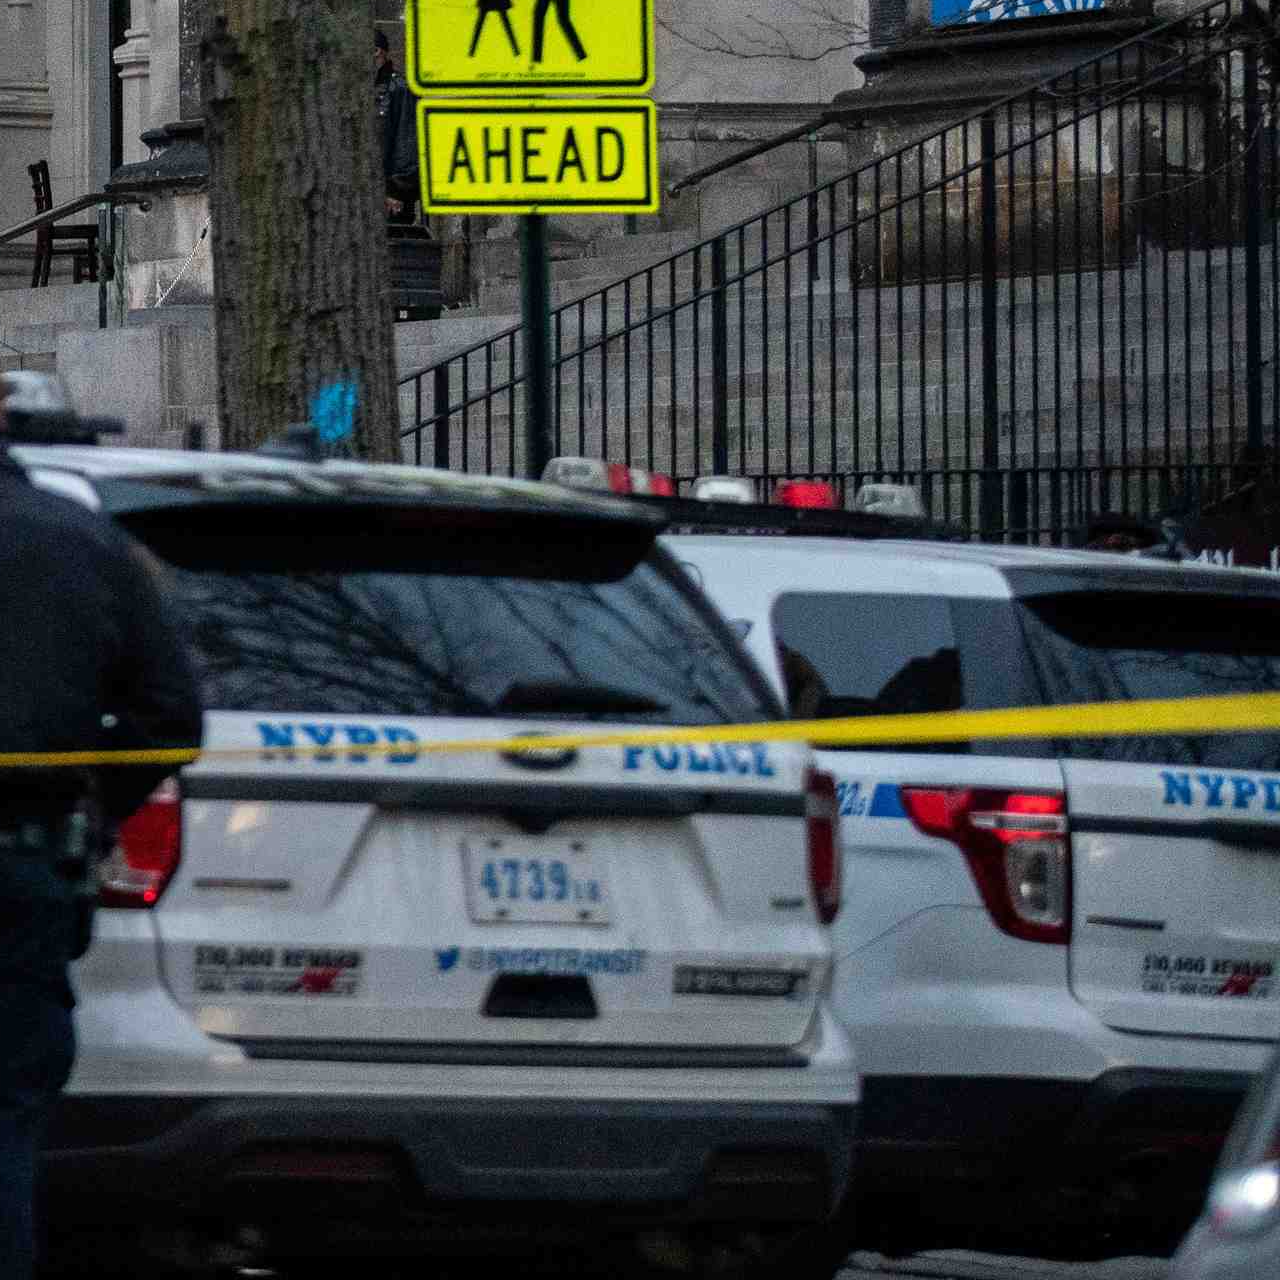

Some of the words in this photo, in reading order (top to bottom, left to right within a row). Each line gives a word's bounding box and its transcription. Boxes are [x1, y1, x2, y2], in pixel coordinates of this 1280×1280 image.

[447, 125, 626, 184] AHEAD
[257, 720, 422, 765] NYPD
[621, 738, 777, 778] POLICE
[481, 858, 569, 901] 4739
